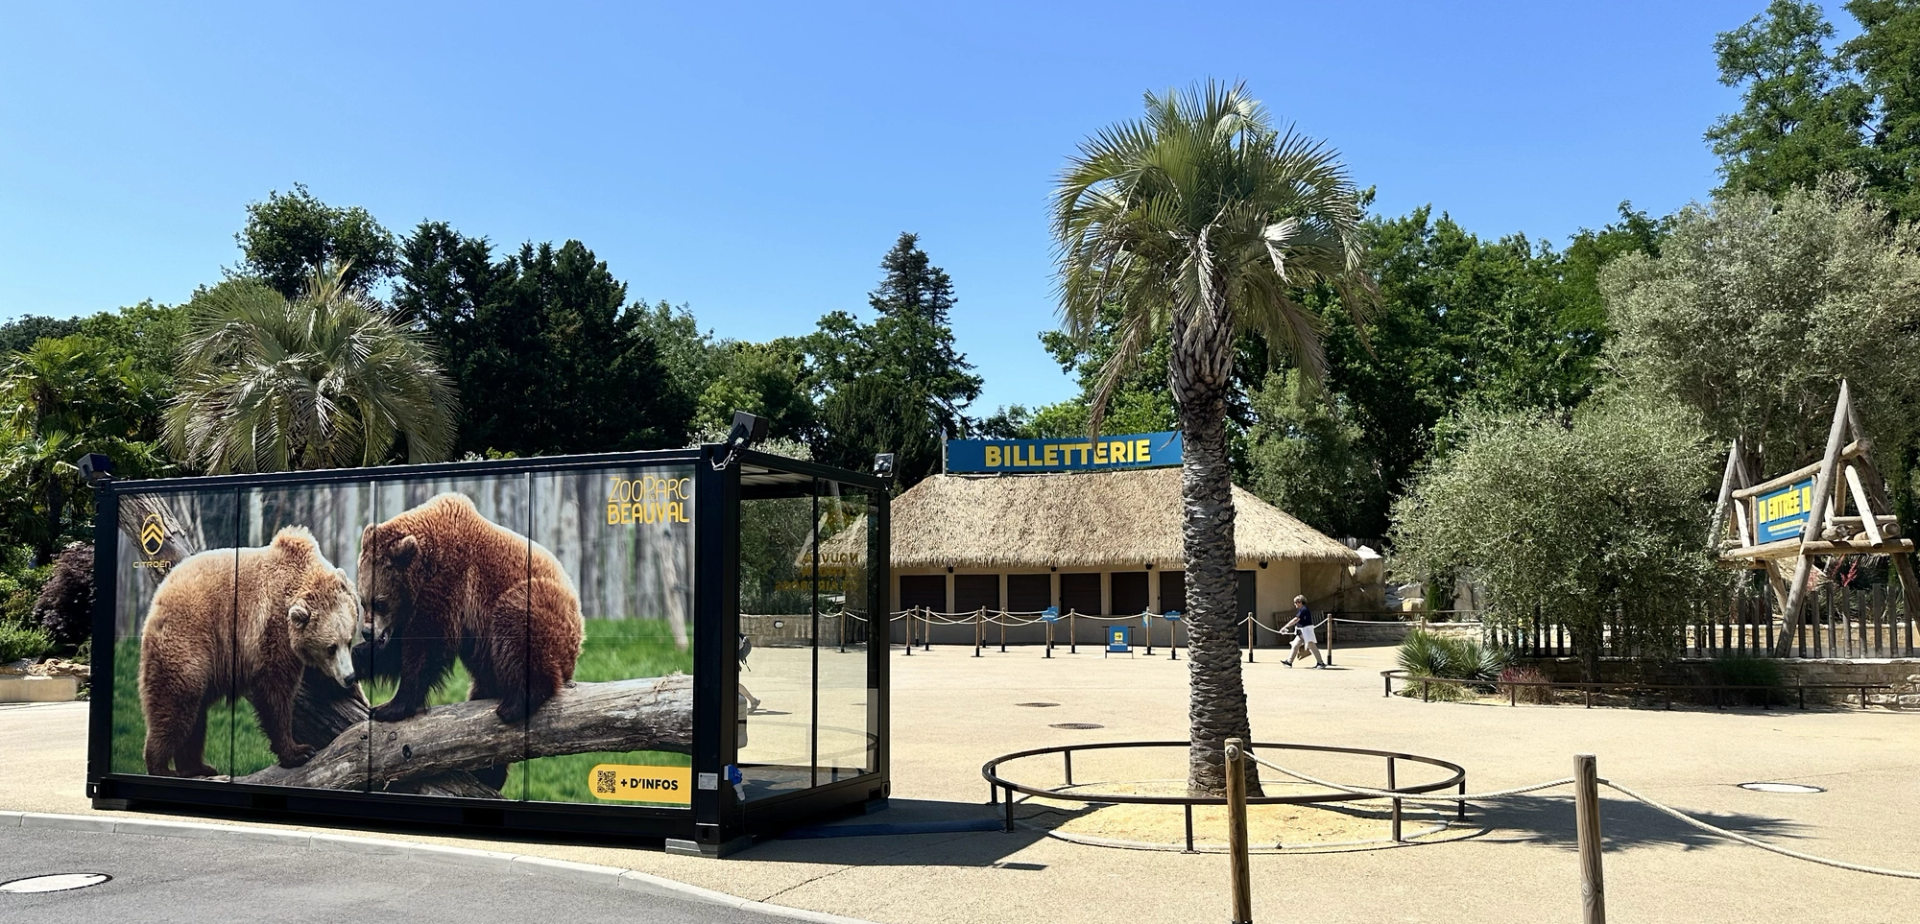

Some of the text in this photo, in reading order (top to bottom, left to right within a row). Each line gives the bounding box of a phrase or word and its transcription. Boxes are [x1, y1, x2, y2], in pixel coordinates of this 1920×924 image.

[985, 439, 1150, 467] BILLETTERIE
[607, 502, 690, 524] BEAUVAL
[630, 778, 678, 790] D'INFOS
